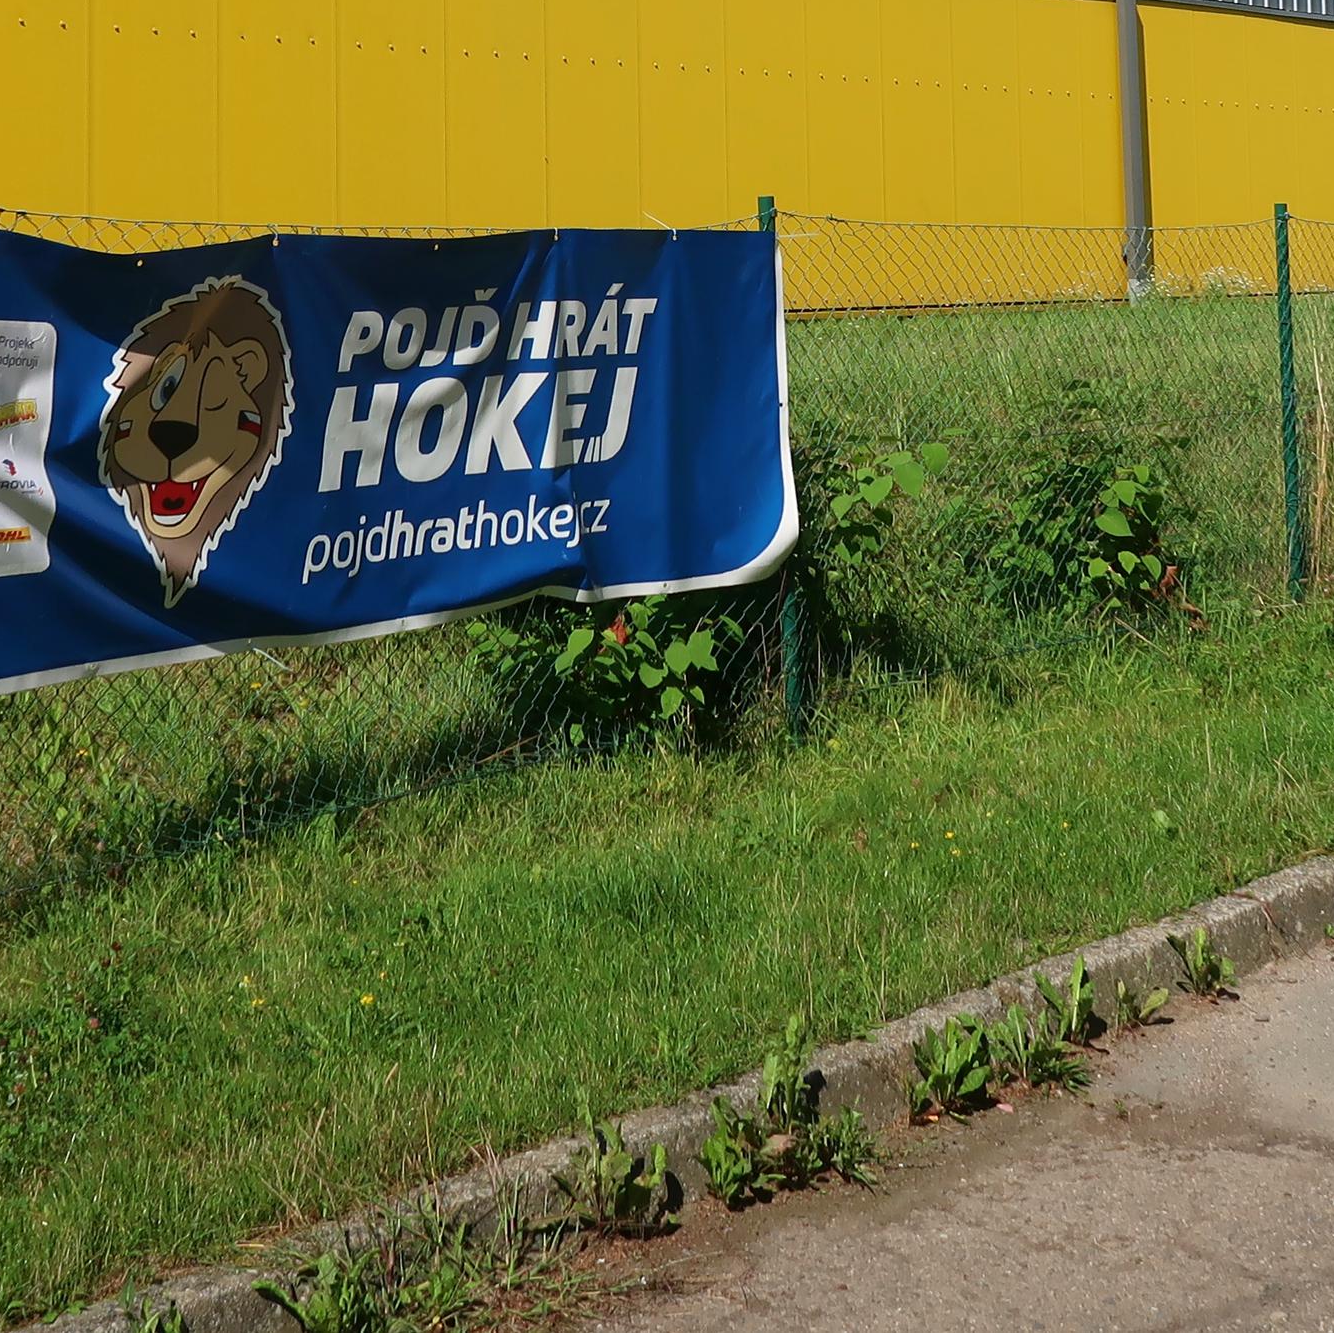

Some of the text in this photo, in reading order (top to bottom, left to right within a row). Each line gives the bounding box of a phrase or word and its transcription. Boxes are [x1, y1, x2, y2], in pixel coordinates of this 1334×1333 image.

[337, 283, 658, 373] POJĎ HRÁT
[317, 366, 638, 493] HOKEJ
[301, 493, 611, 585] pojdhrathokejcz
